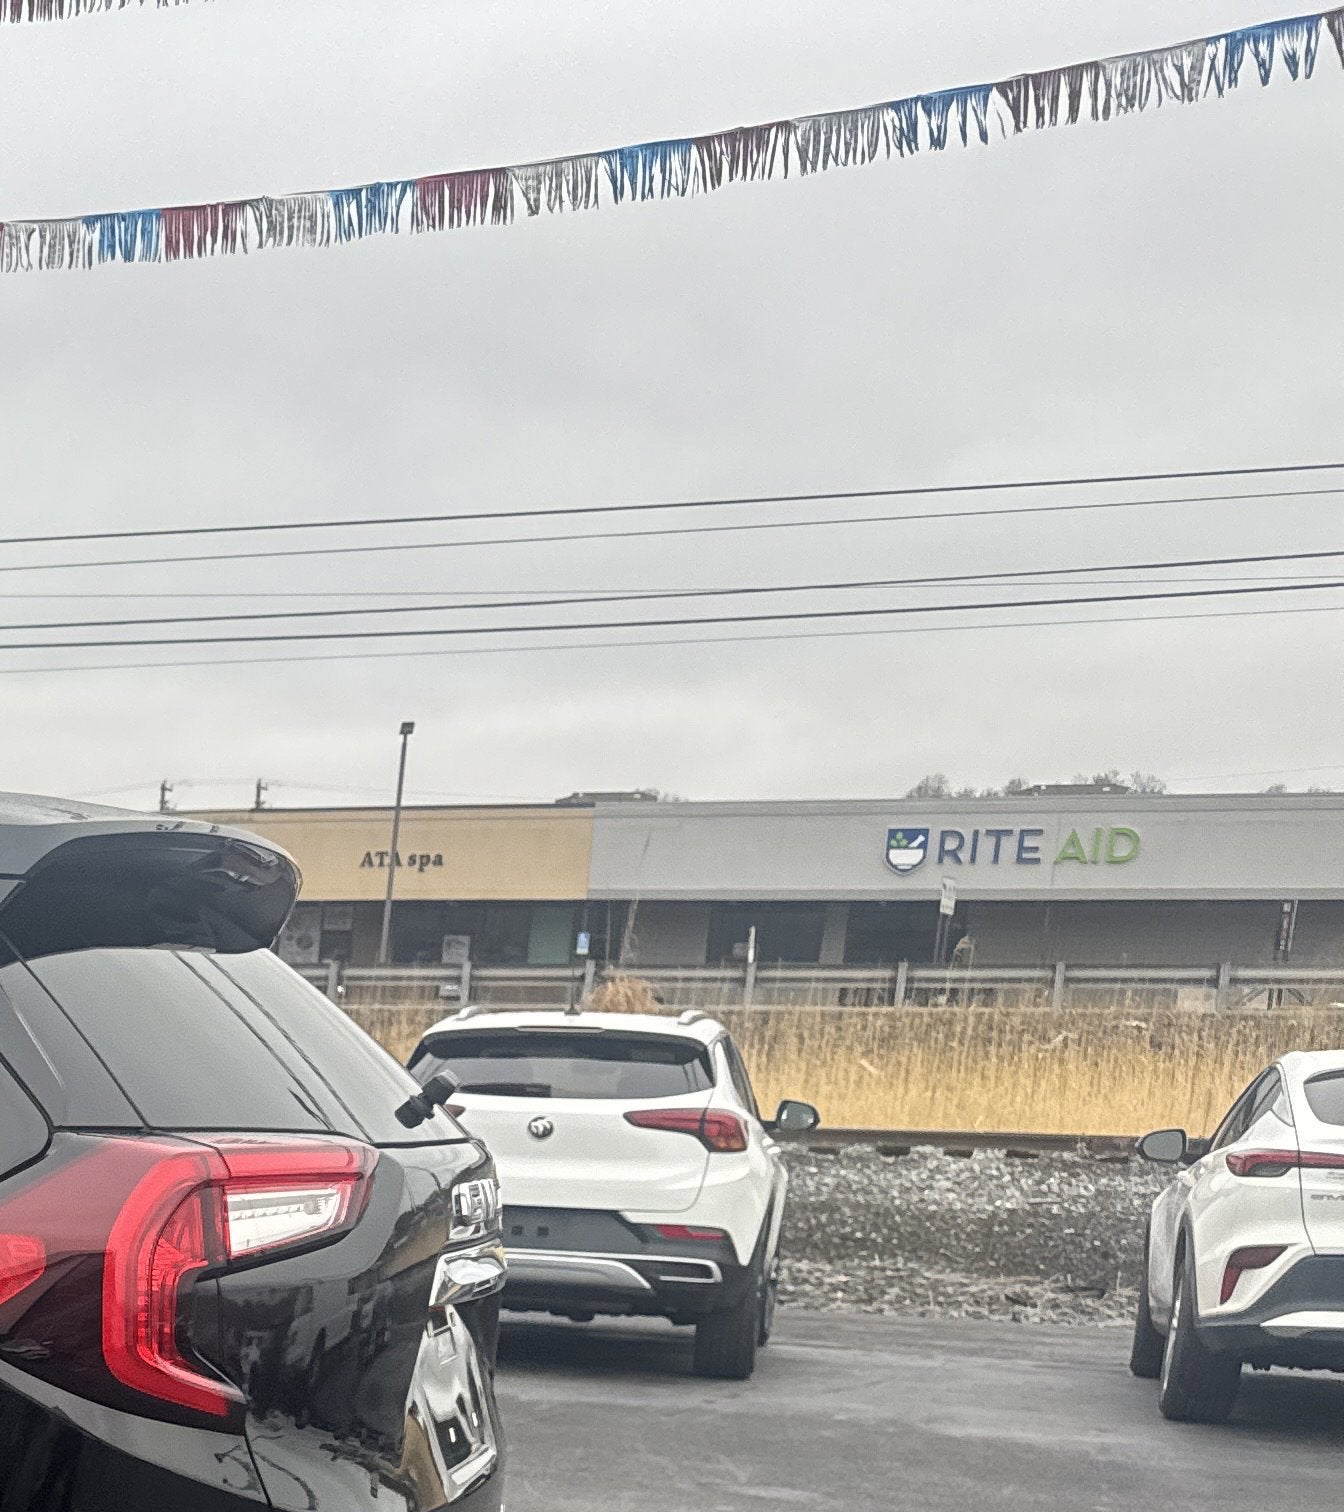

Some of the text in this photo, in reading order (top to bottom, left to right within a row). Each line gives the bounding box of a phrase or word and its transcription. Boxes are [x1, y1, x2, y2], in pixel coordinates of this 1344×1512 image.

[937, 826, 1142, 865] RITE AID
[359, 850, 443, 873] ATA spa
